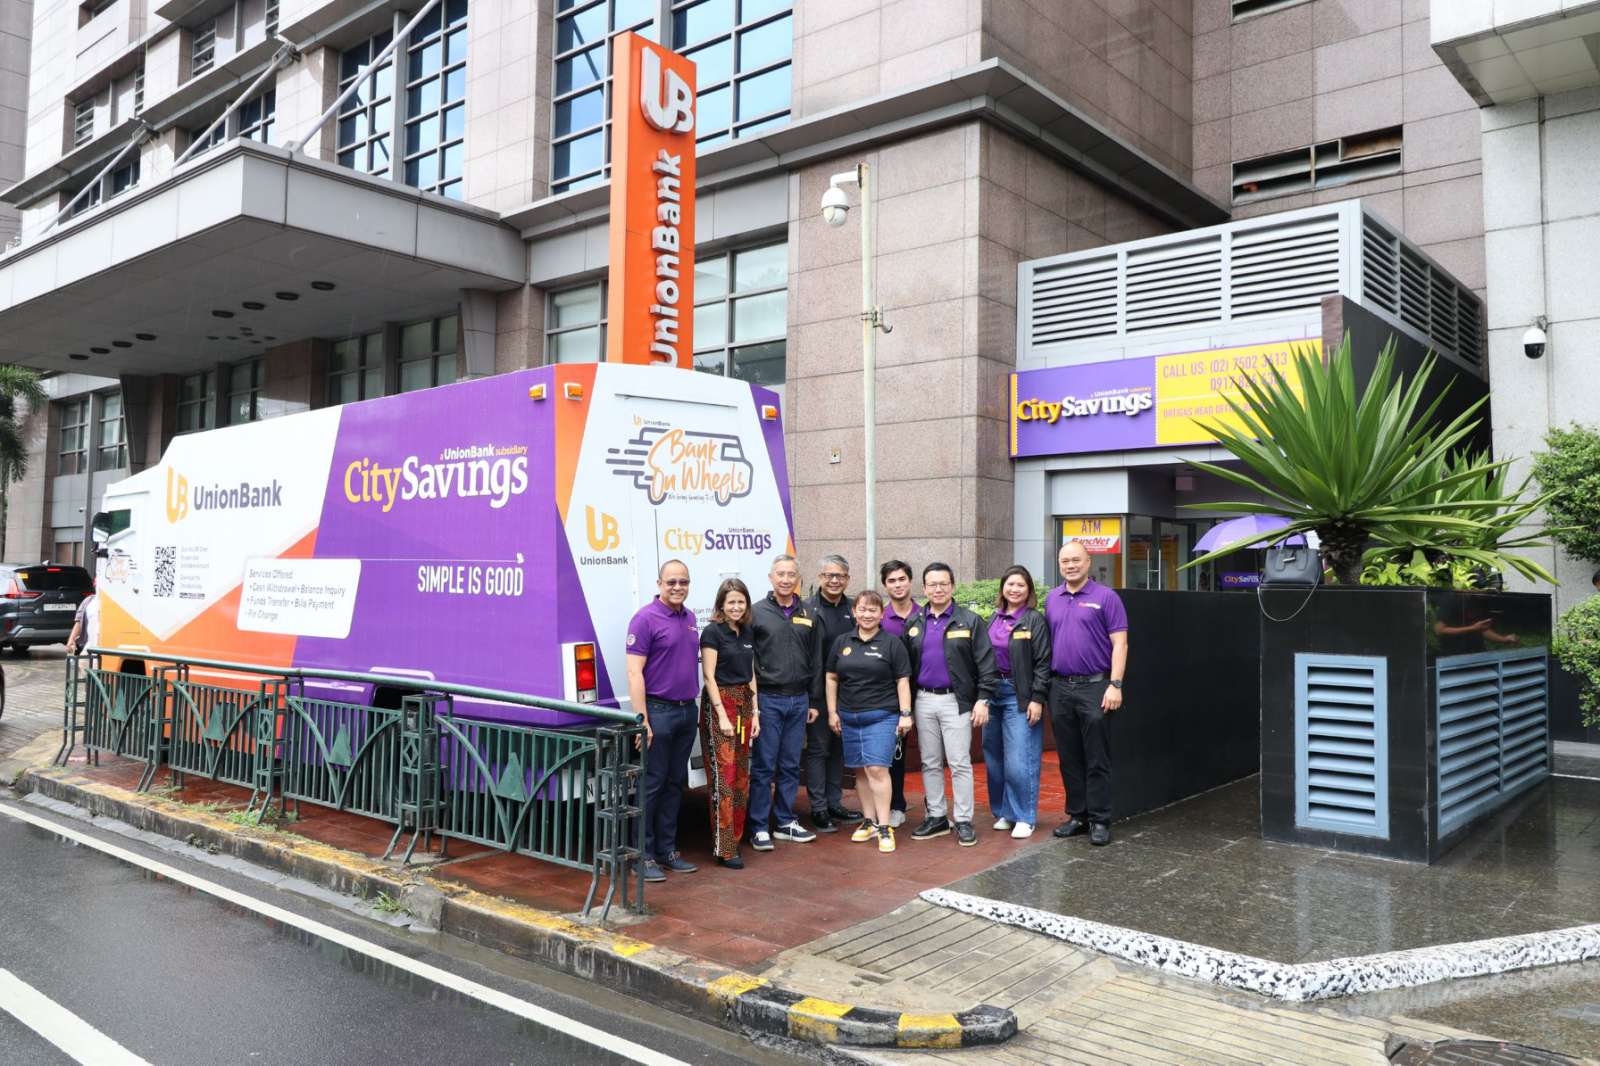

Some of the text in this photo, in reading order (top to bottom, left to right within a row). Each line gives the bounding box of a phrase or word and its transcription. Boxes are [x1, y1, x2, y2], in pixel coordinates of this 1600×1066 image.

[648, 148, 681, 367] UnionBank
[1163, 363, 1187, 378] CALL
[1017, 392, 1152, 424] CitySavings
[444, 443, 494, 460] UnionBank
[660, 428, 718, 465] Bank
[193, 479, 282, 510] UnionBank
[344, 456, 528, 512] CitySavings
[682, 459, 745, 501] Wheels
[663, 527, 772, 555] CitySavings
[1081, 519, 1101, 533] ATM
[580, 556, 628, 566] UnionBank
[417, 565, 523, 596] SIMPLE IS GOOD
